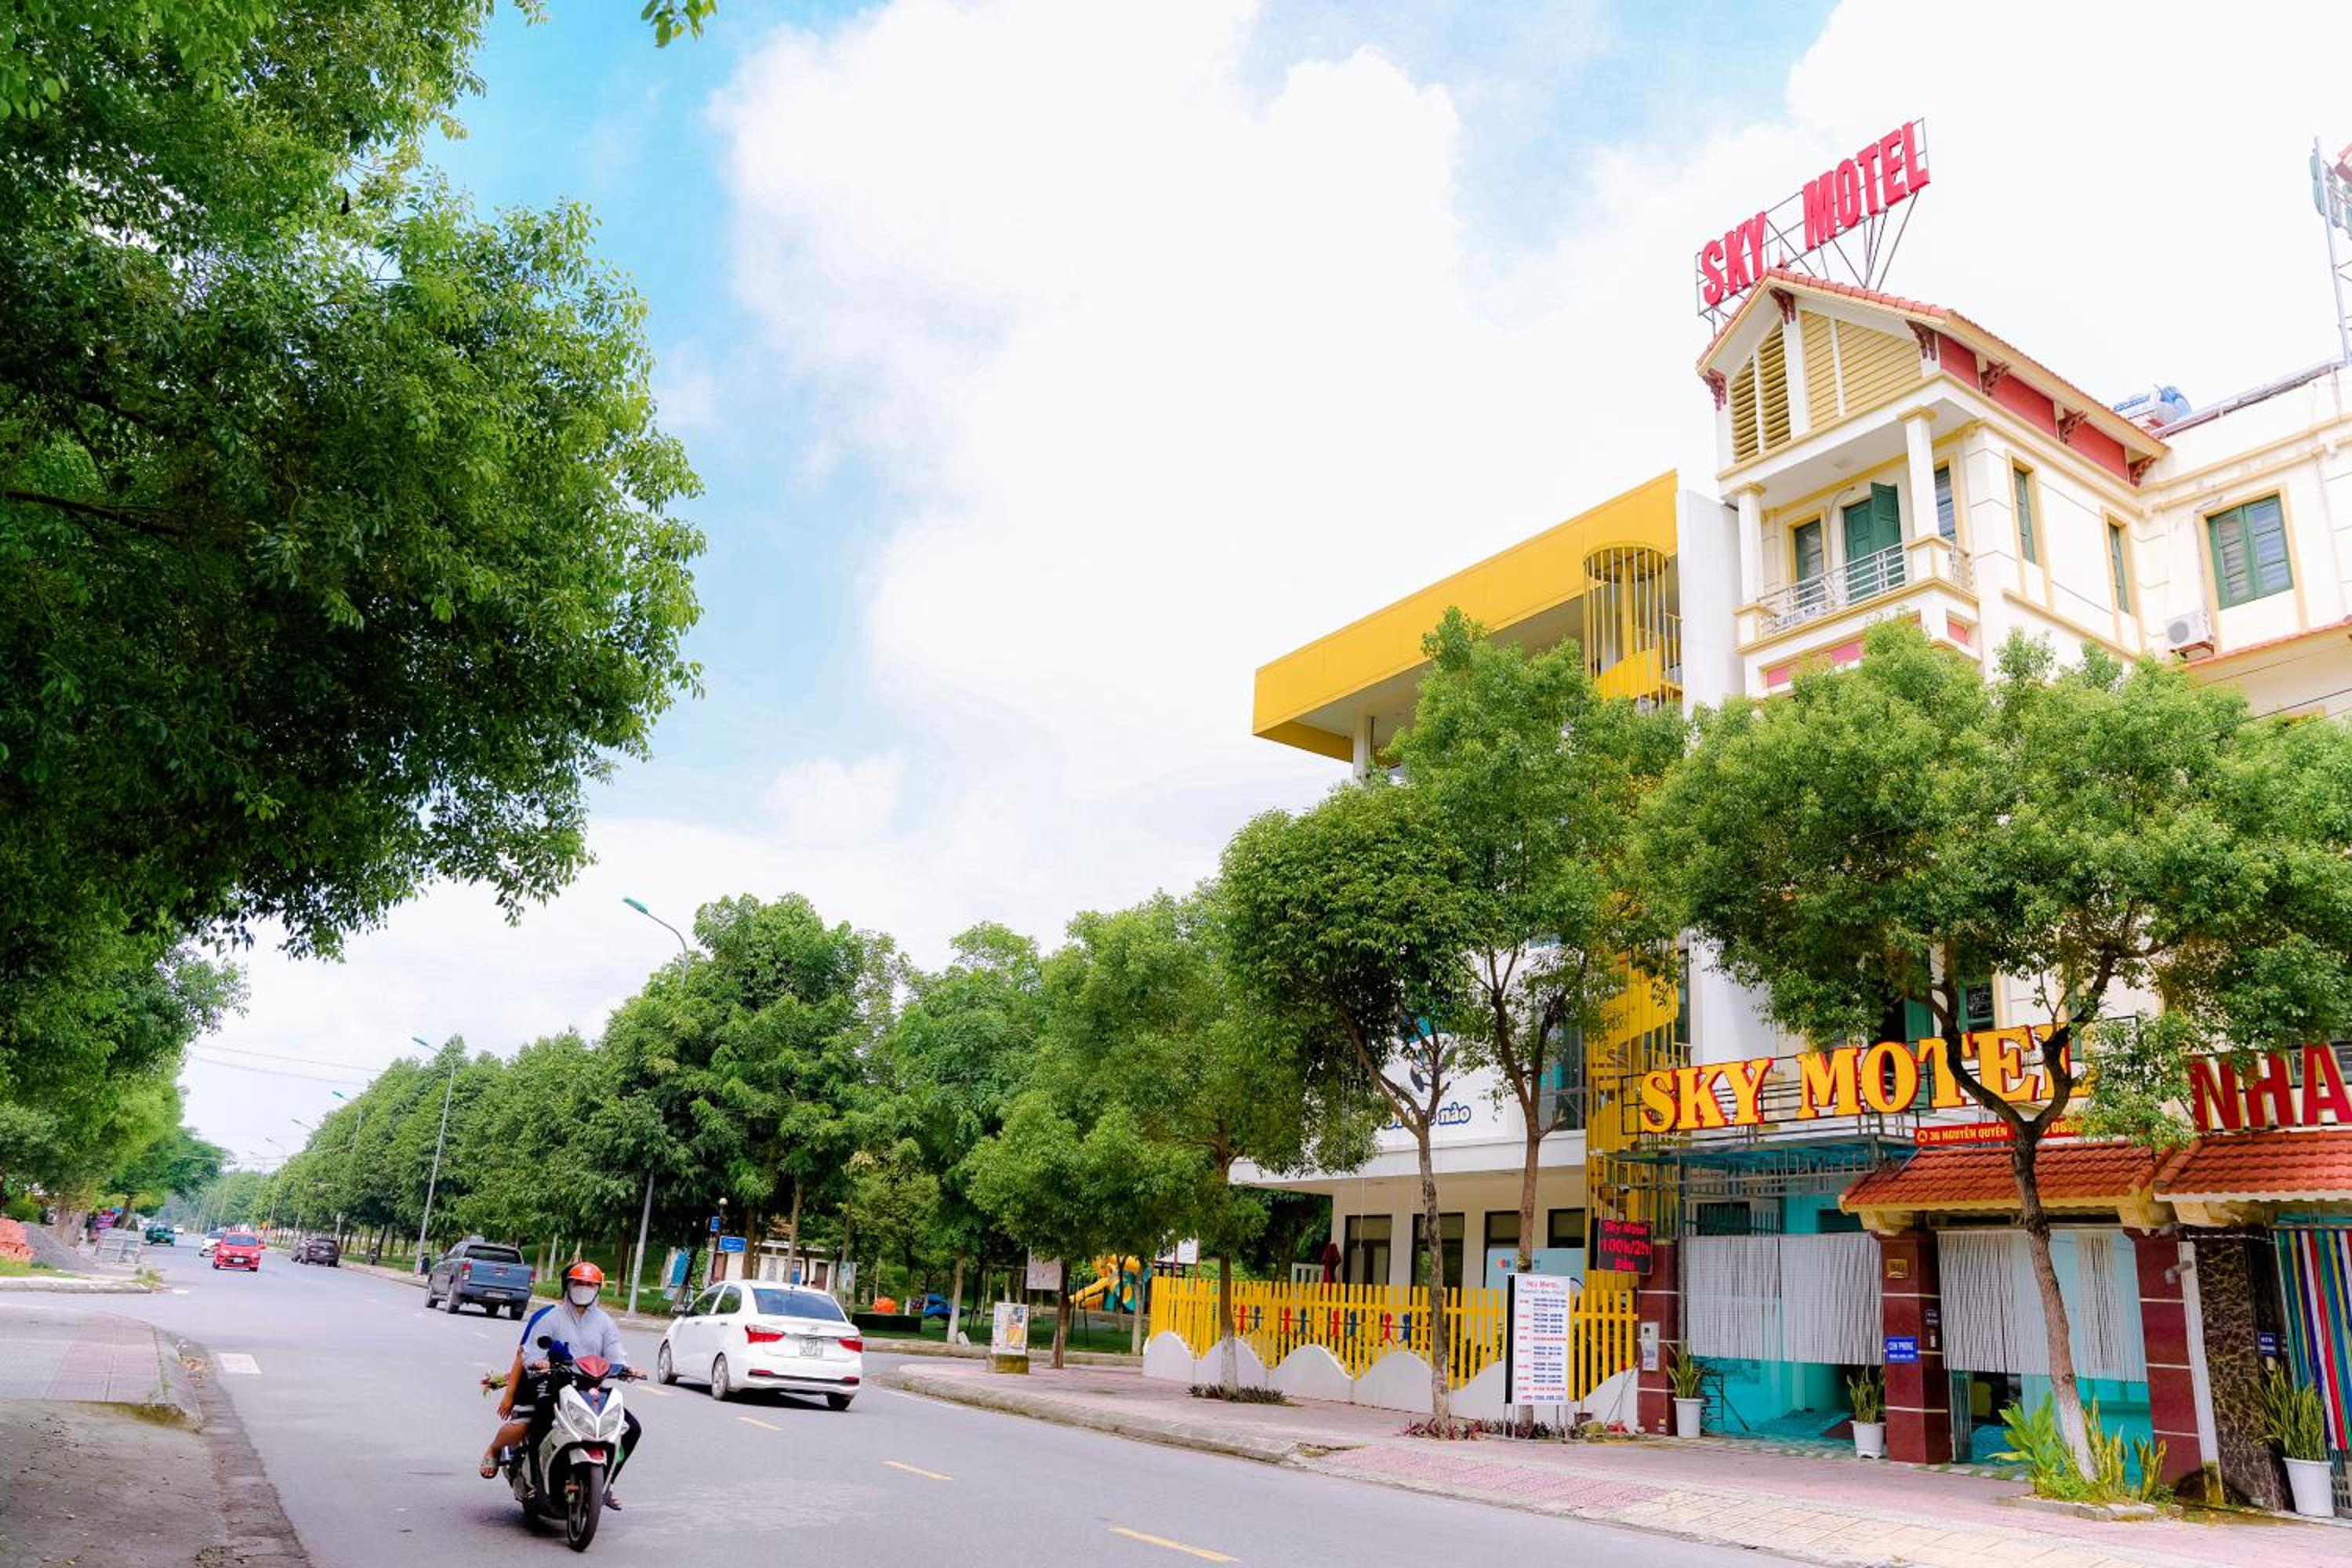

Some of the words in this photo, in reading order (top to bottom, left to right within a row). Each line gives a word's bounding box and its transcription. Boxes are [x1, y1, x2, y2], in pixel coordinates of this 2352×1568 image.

[1700, 212, 1766, 306] SKY
[1803, 121, 1930, 251] MOTEL
[1640, 1056, 1773, 1134] SKY
